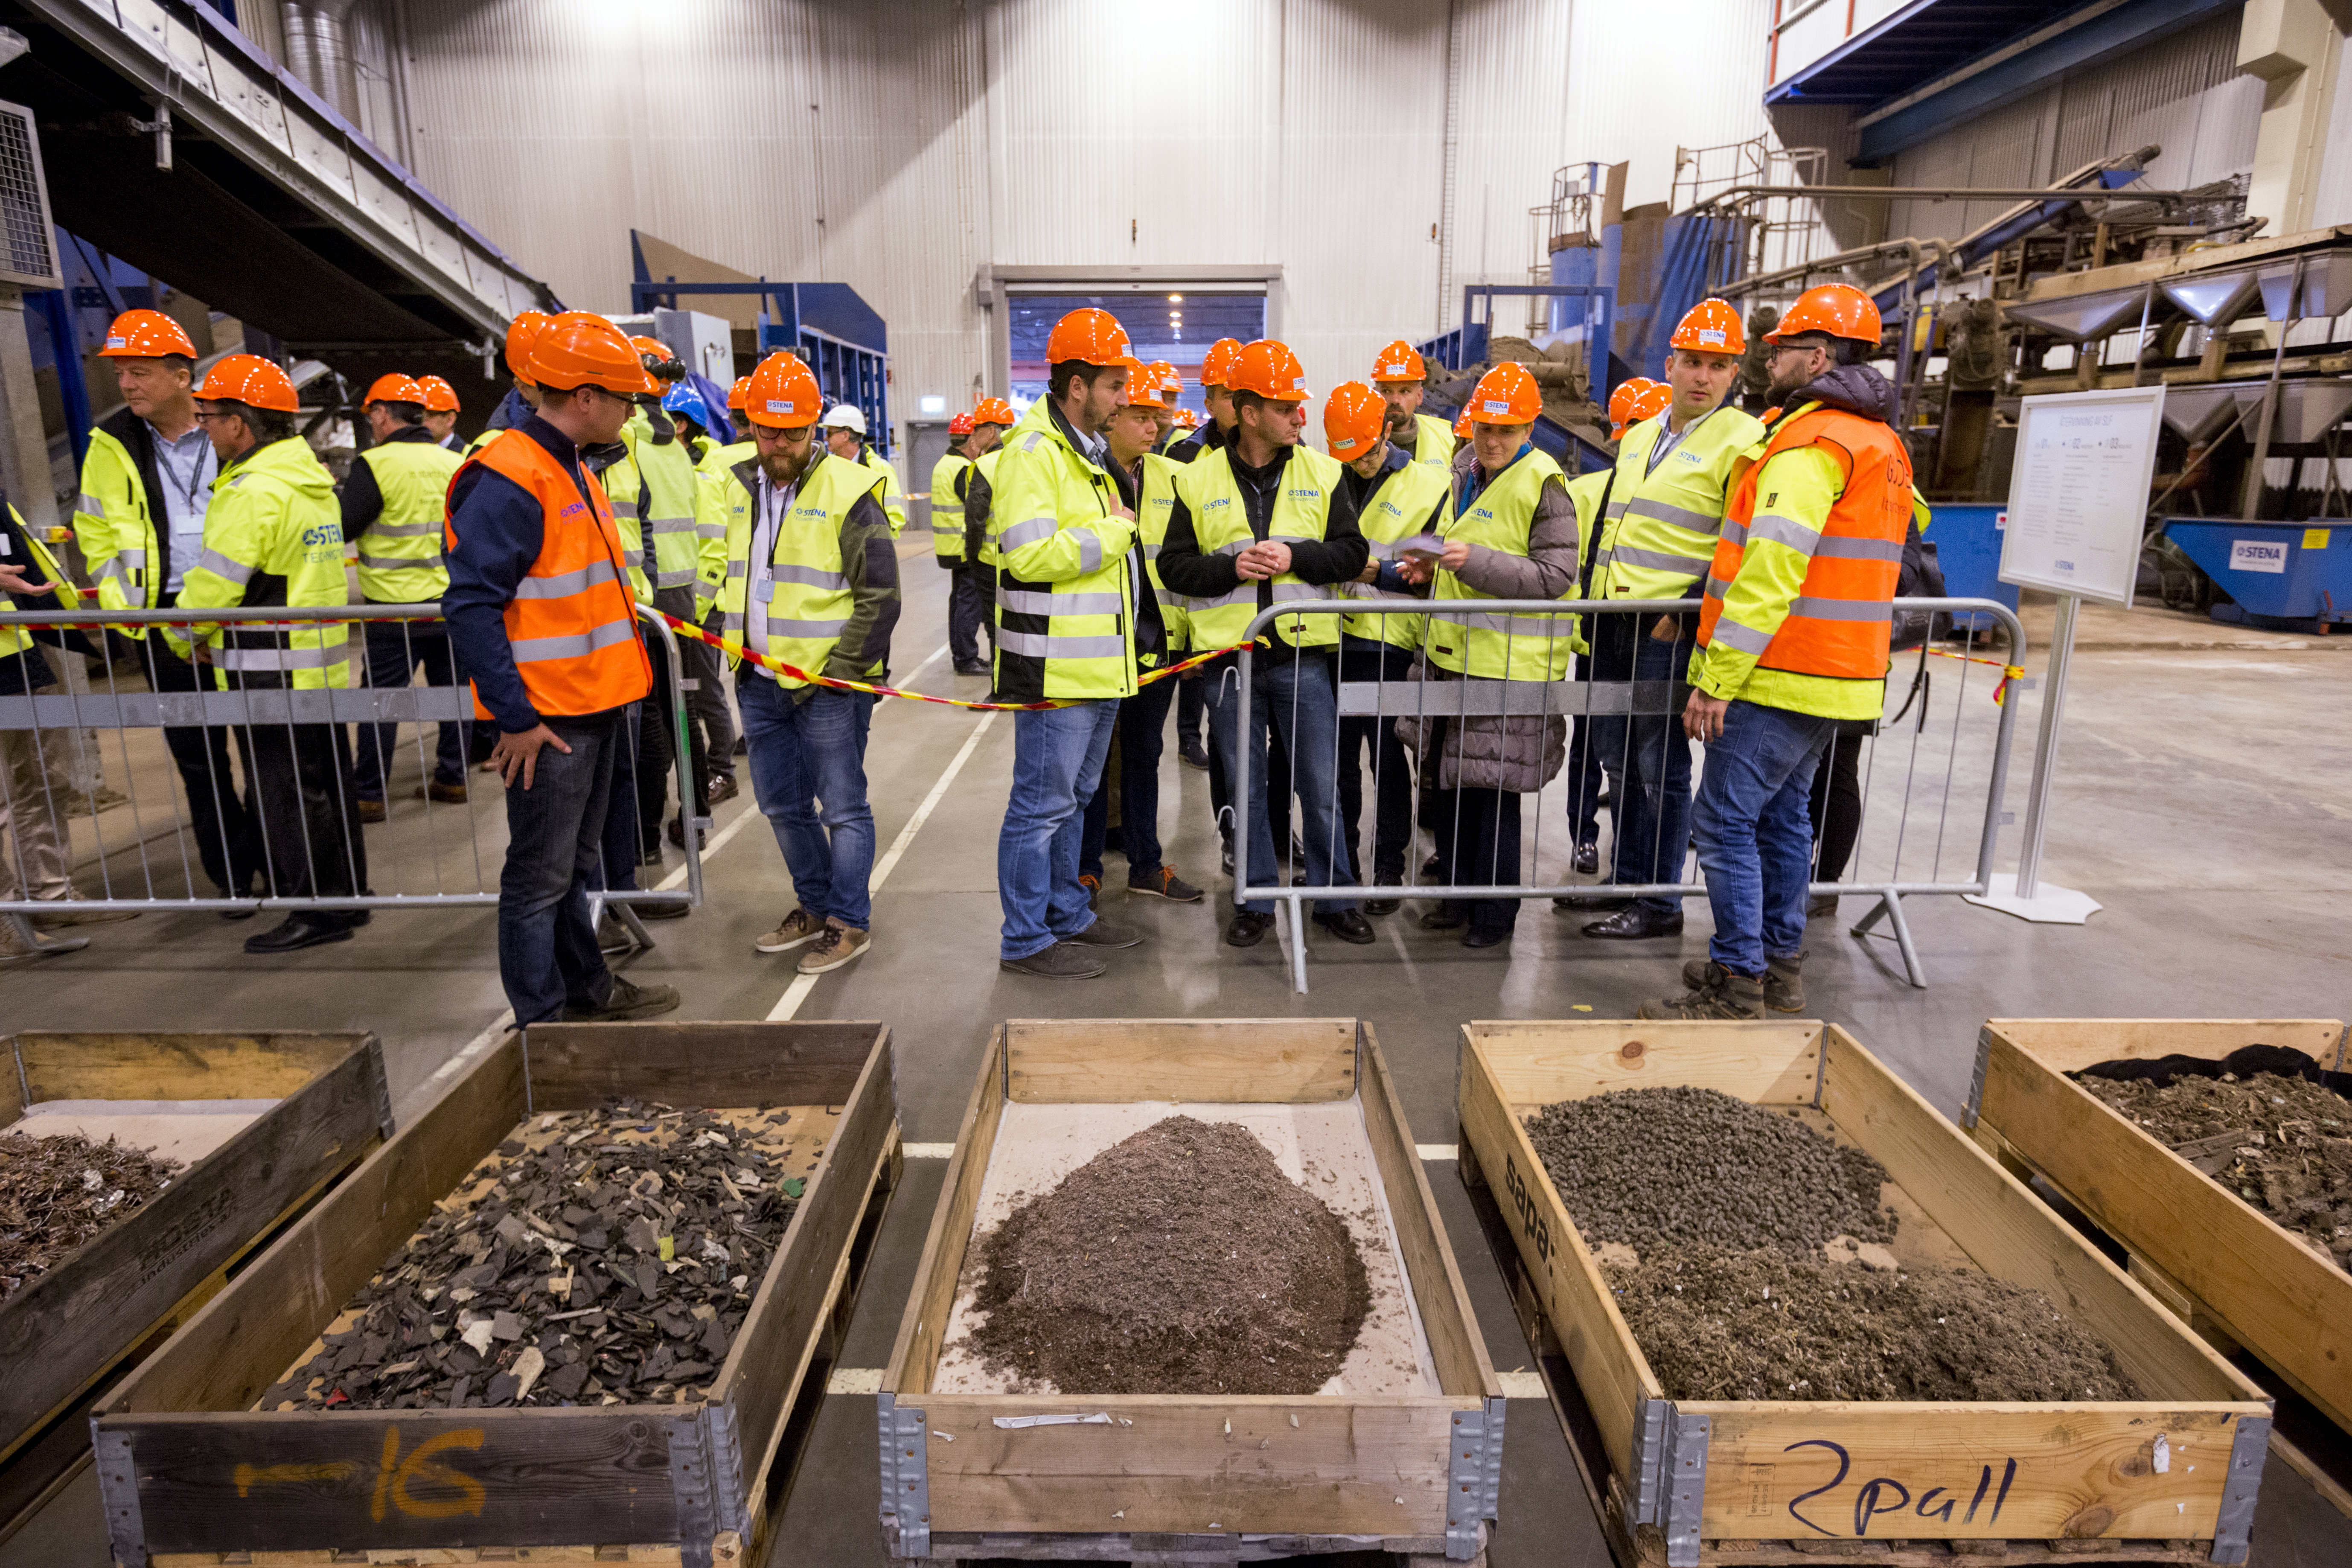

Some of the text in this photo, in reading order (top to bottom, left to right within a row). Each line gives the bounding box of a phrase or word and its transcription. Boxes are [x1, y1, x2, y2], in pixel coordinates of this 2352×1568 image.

[1679, 451, 1702, 463] STENA
[803, 509, 827, 518] STENA
[2245, 547, 2280, 560] STENA
[1505, 1152, 1549, 1263] sapa
